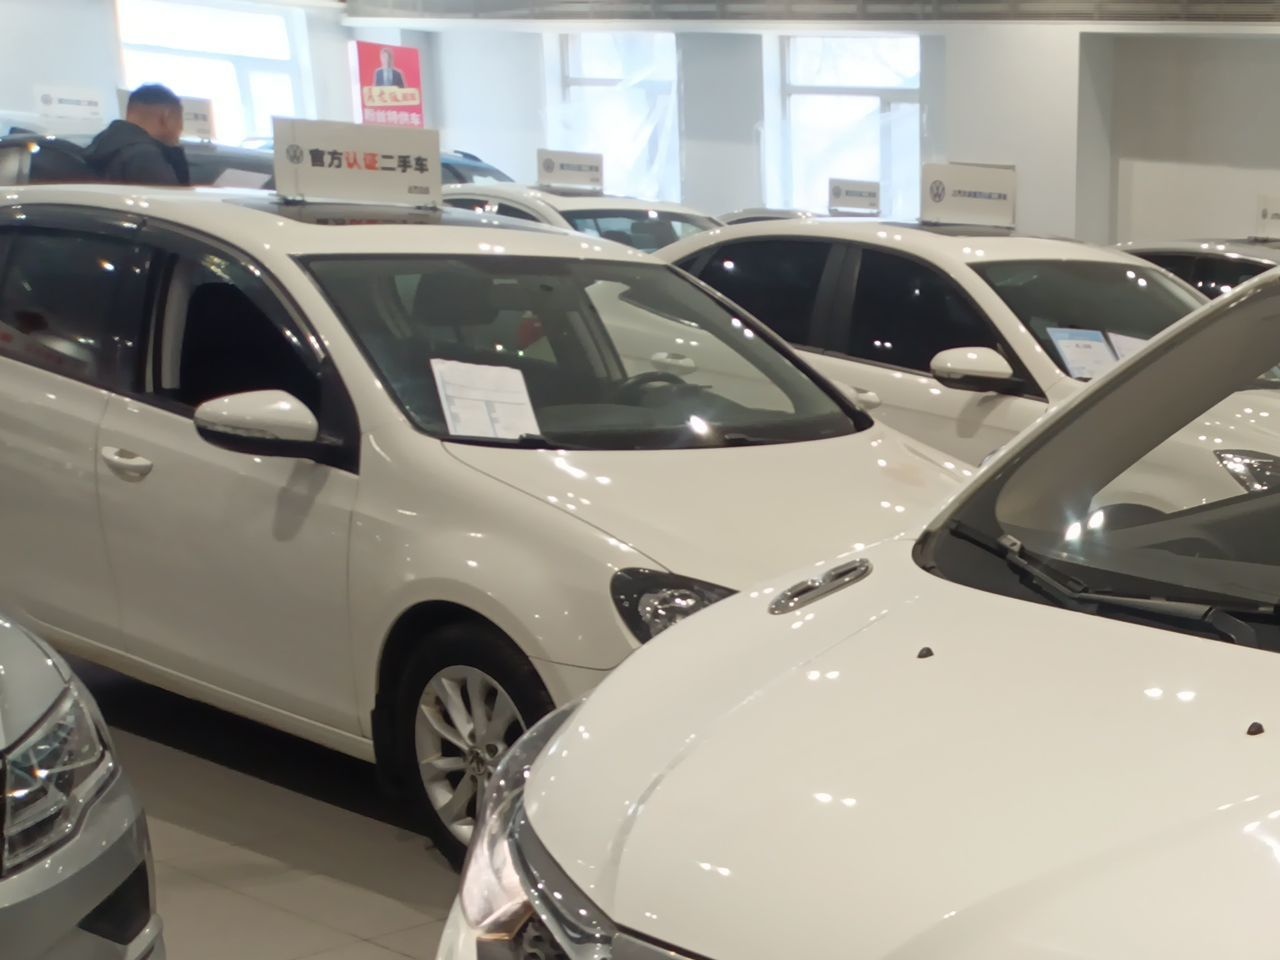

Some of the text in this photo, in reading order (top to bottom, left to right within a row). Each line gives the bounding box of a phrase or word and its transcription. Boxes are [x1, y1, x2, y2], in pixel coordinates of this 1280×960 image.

[309, 148, 429, 174] 官方认证二手车
